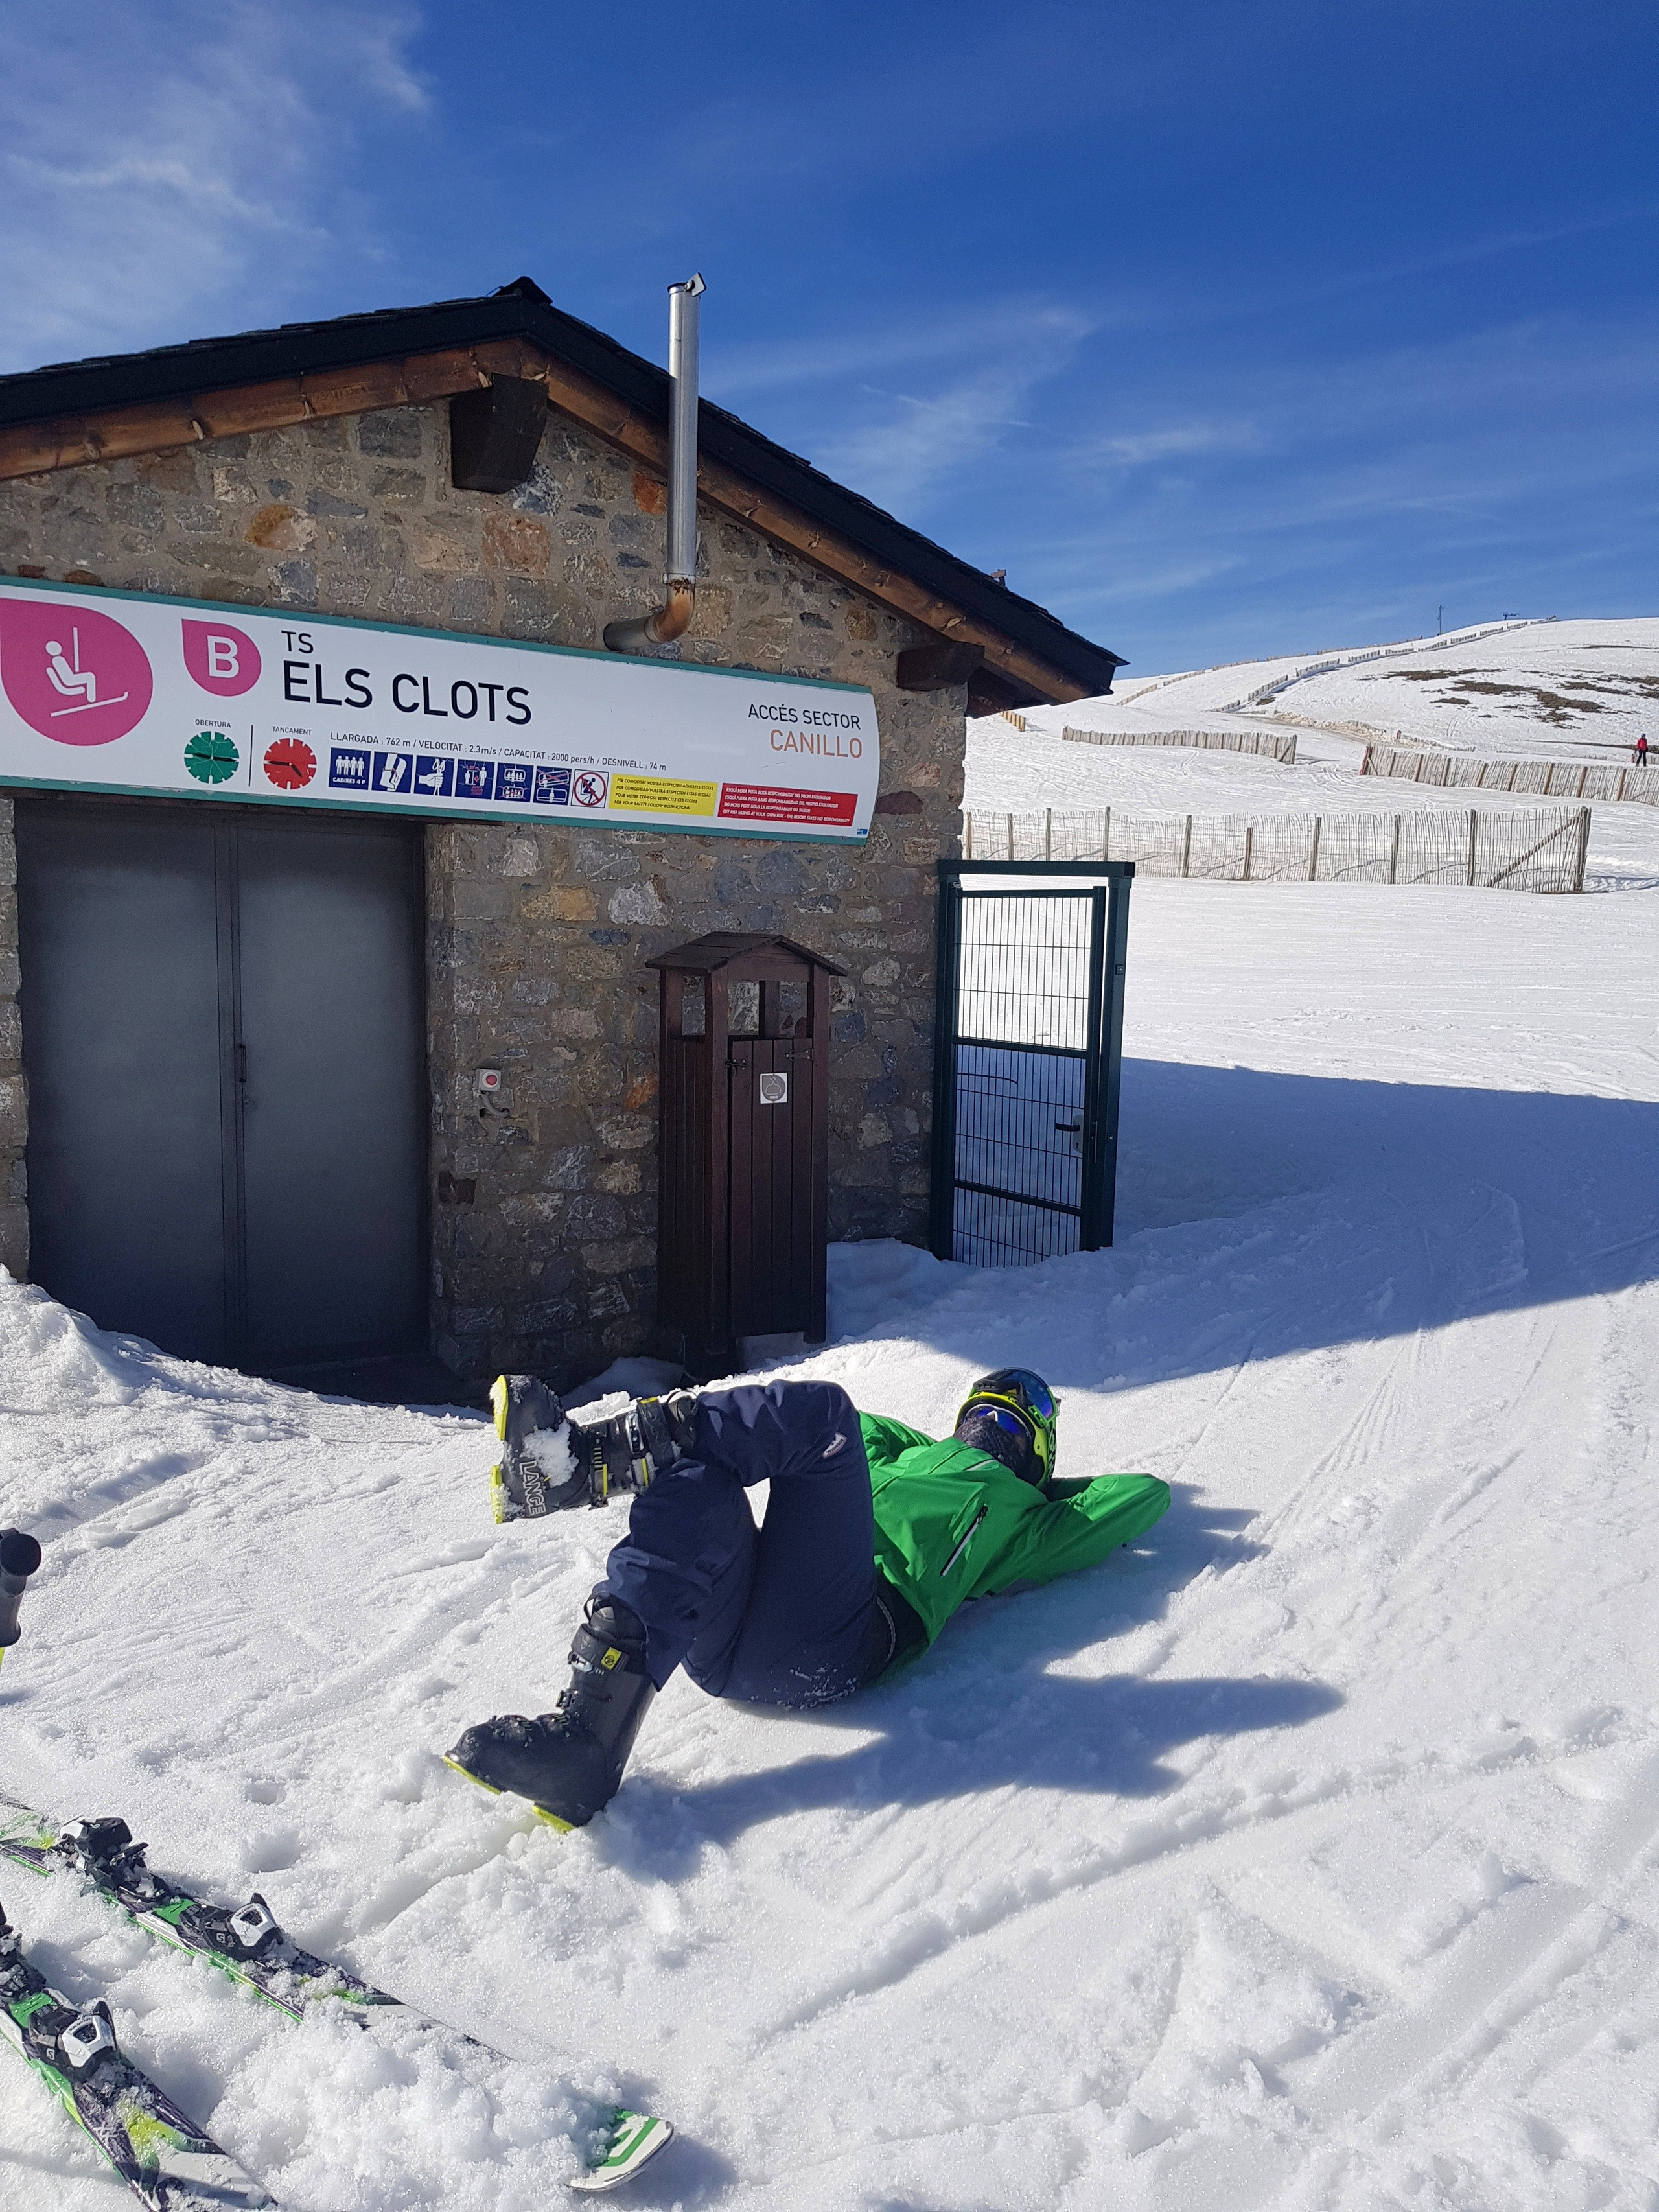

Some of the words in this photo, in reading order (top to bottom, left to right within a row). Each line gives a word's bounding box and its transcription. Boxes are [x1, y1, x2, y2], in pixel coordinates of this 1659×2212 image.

[207, 635, 239, 678] B
[281, 630, 314, 654] TS
[284, 660, 373, 707] ELS
[392, 673, 532, 724] CLOTS
[195, 719, 231, 728] OBERTURA
[272, 726, 312, 735] TANCAMENT
[748, 704, 798, 723] ACCÉS
[803, 710, 861, 730] SECTOR
[331, 732, 379, 744] LLARGADA
[386, 737, 400, 746] 762
[419, 740, 463, 751] VELOCITAT
[504, 748, 546, 760] CAPACITAT
[551, 753, 569, 762] 2000
[570, 754, 595, 764] pers/h
[602, 757, 644, 769] DESNIVELL
[649, 762, 658, 770] 74
[771, 729, 863, 759] CANILLO
[519, 1460, 546, 1515] LANGE
